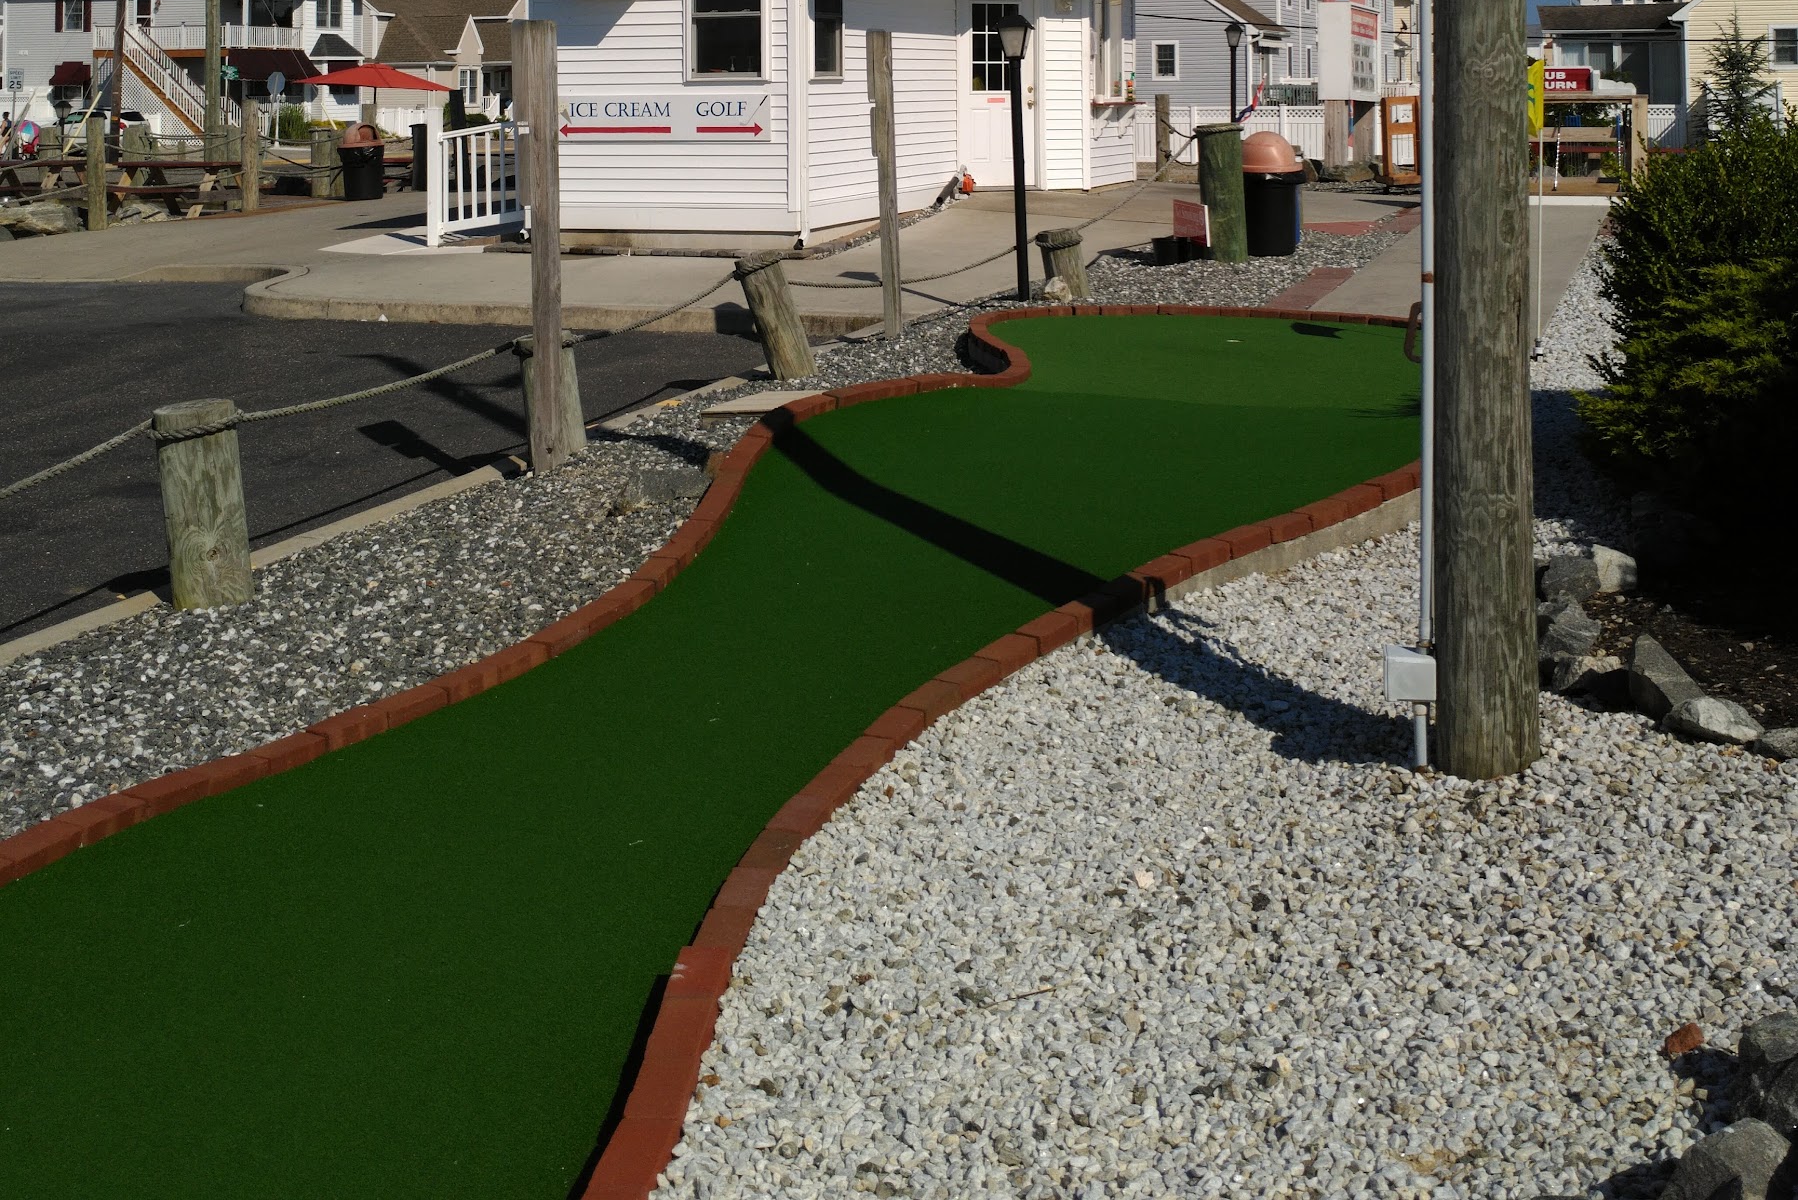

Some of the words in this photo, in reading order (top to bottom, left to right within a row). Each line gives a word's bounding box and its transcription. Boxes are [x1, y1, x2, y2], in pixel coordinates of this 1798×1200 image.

[1544, 71, 1566, 80] UB
[9, 80, 21, 89] 25
[1544, 81, 1577, 89] URN
[569, 102, 598, 118] ICE
[604, 101, 671, 118] CREAM
[696, 100, 748, 117] GOLF
